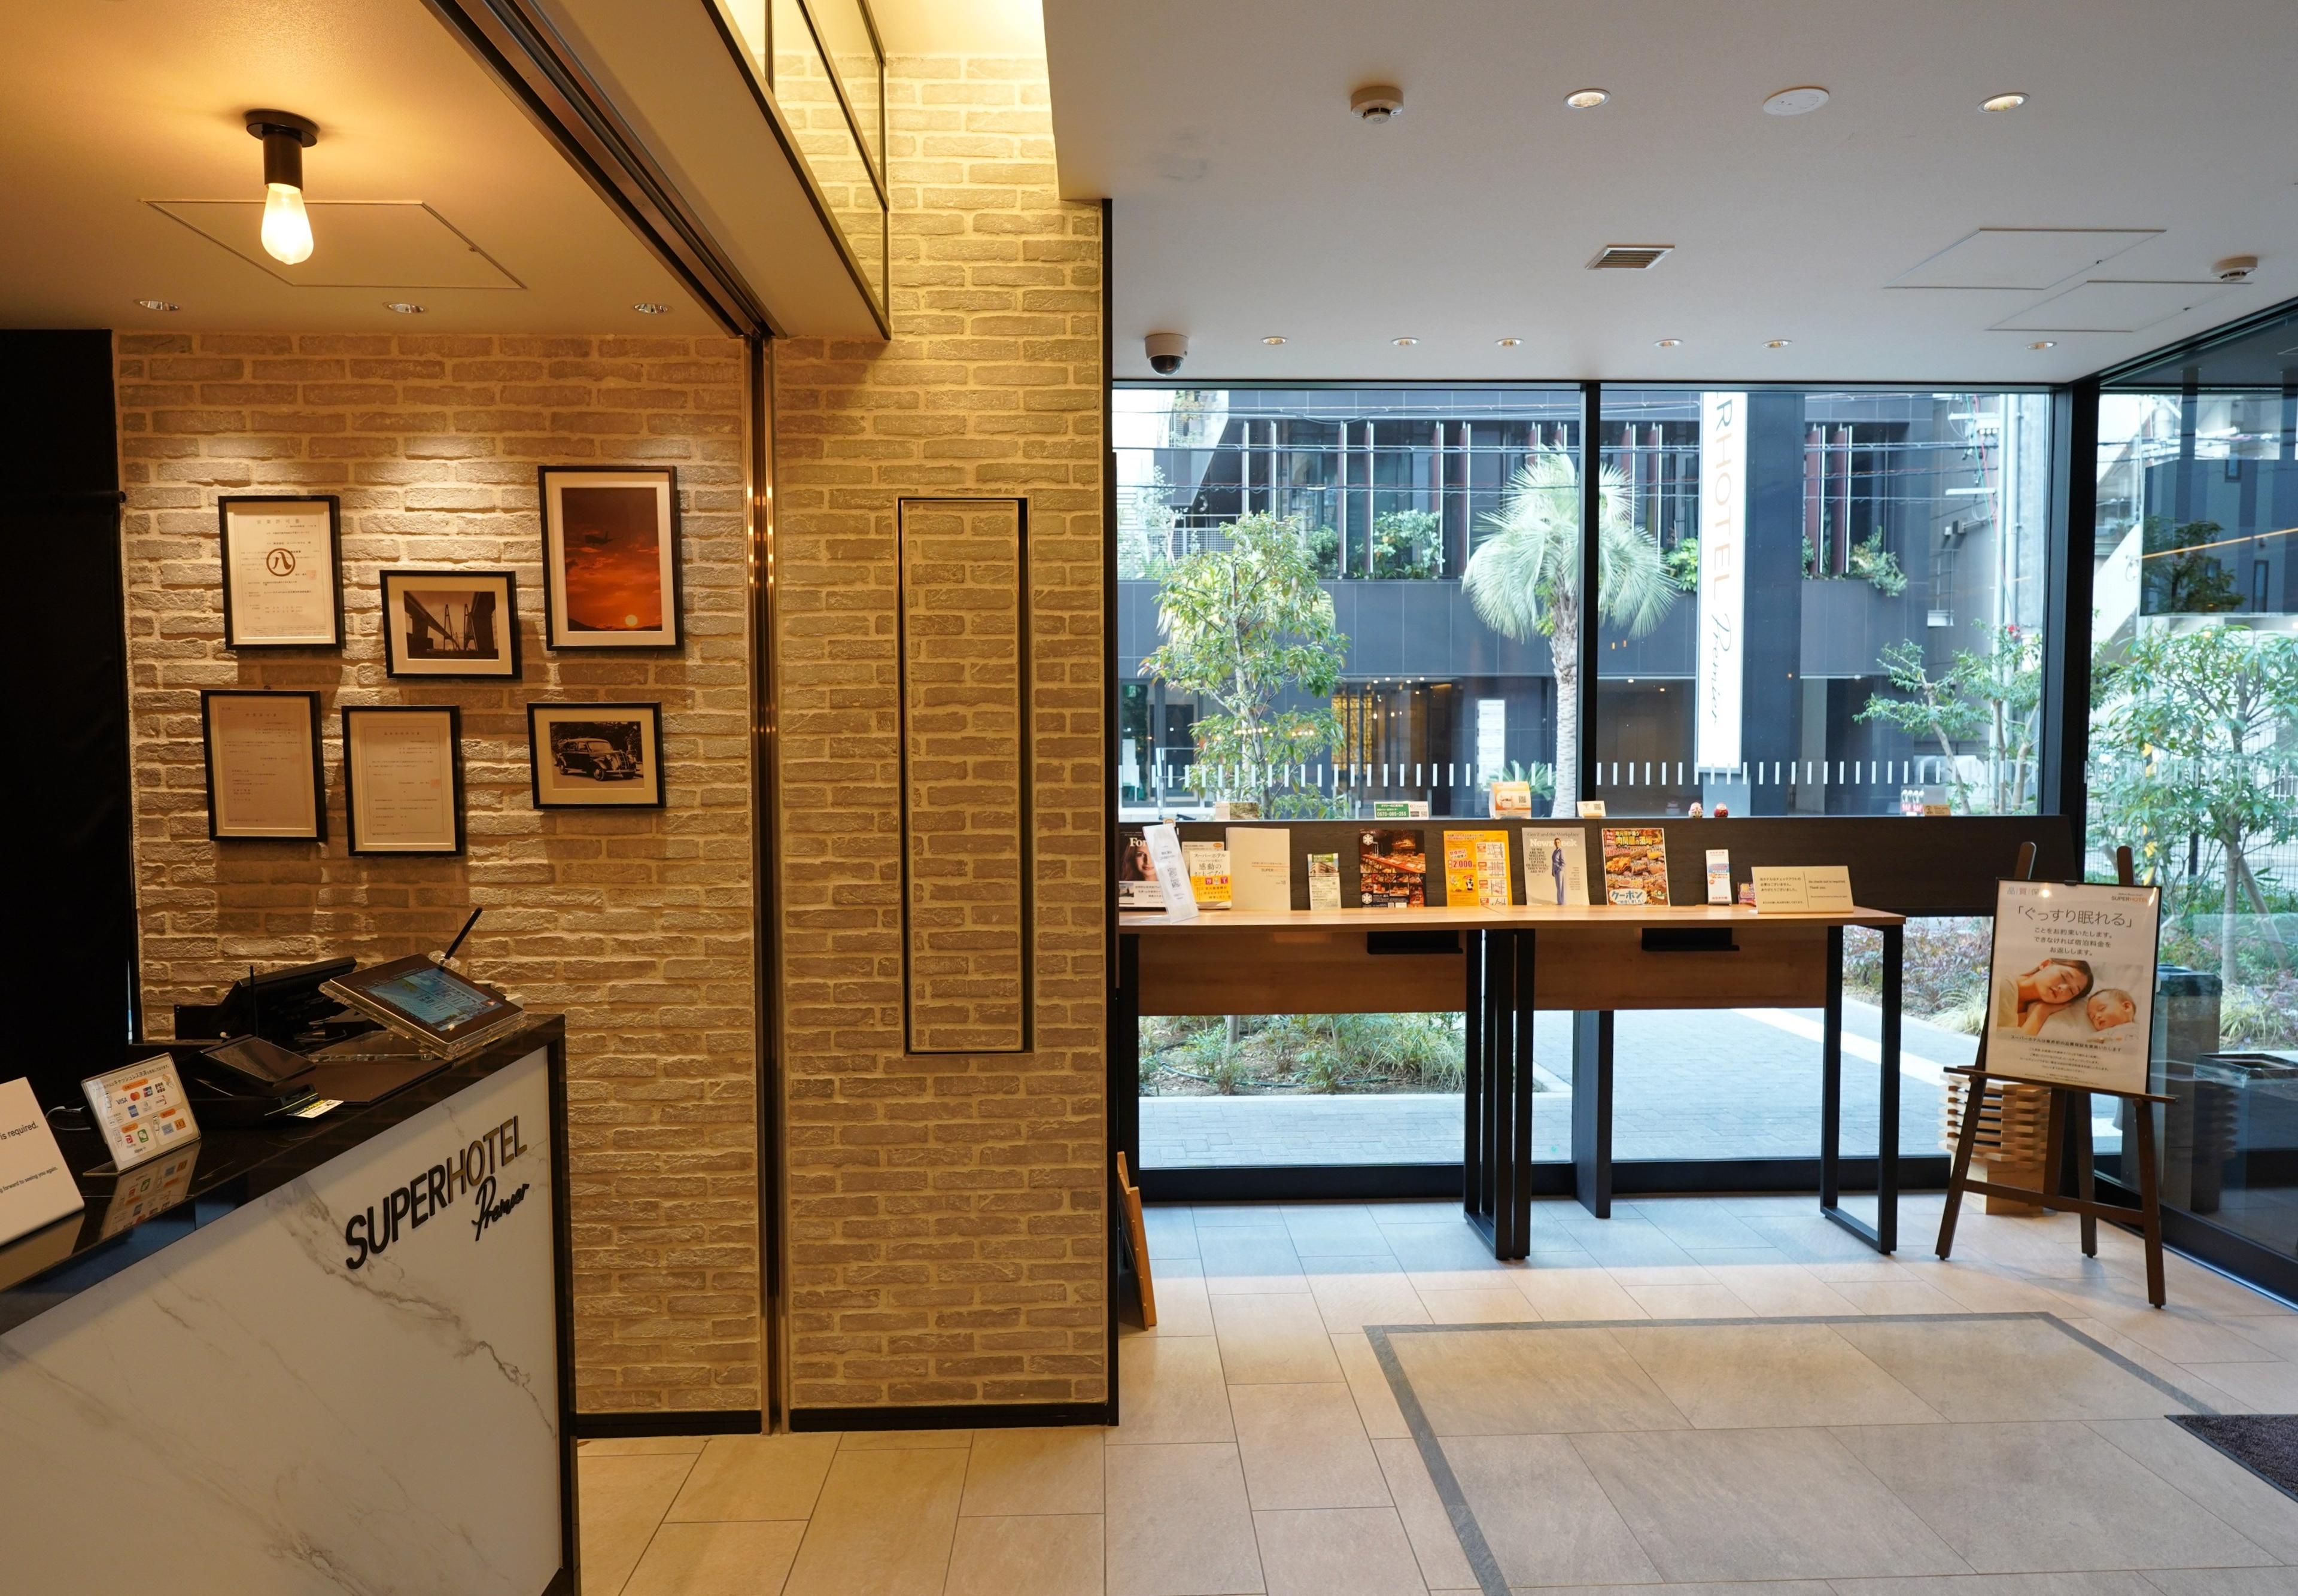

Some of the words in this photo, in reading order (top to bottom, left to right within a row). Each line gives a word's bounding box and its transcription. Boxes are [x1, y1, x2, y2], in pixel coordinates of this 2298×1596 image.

[1714, 393, 1732, 600] RHOTEL
[1711, 613, 1731, 728] Premier
[1530, 838, 1577, 847] Newseek
[1612, 890, 1643, 901] クーポン
[2018, 905, 2133, 928] 「ぐっすり眠れる」
[2034, 936, 2111, 948] できなければ宿泊料金を
[2035, 928, 2112, 939] ことをお約束いたします。
[2050, 947, 2093, 956] お返しします。
[8, 1121, 39, 1138] required.
[3, 1181, 19, 1191] forward
[25, 1173, 39, 1182] seeing
[346, 1115, 527, 1269] SUPERHOTEL
[471, 1176, 530, 1241] Premier
